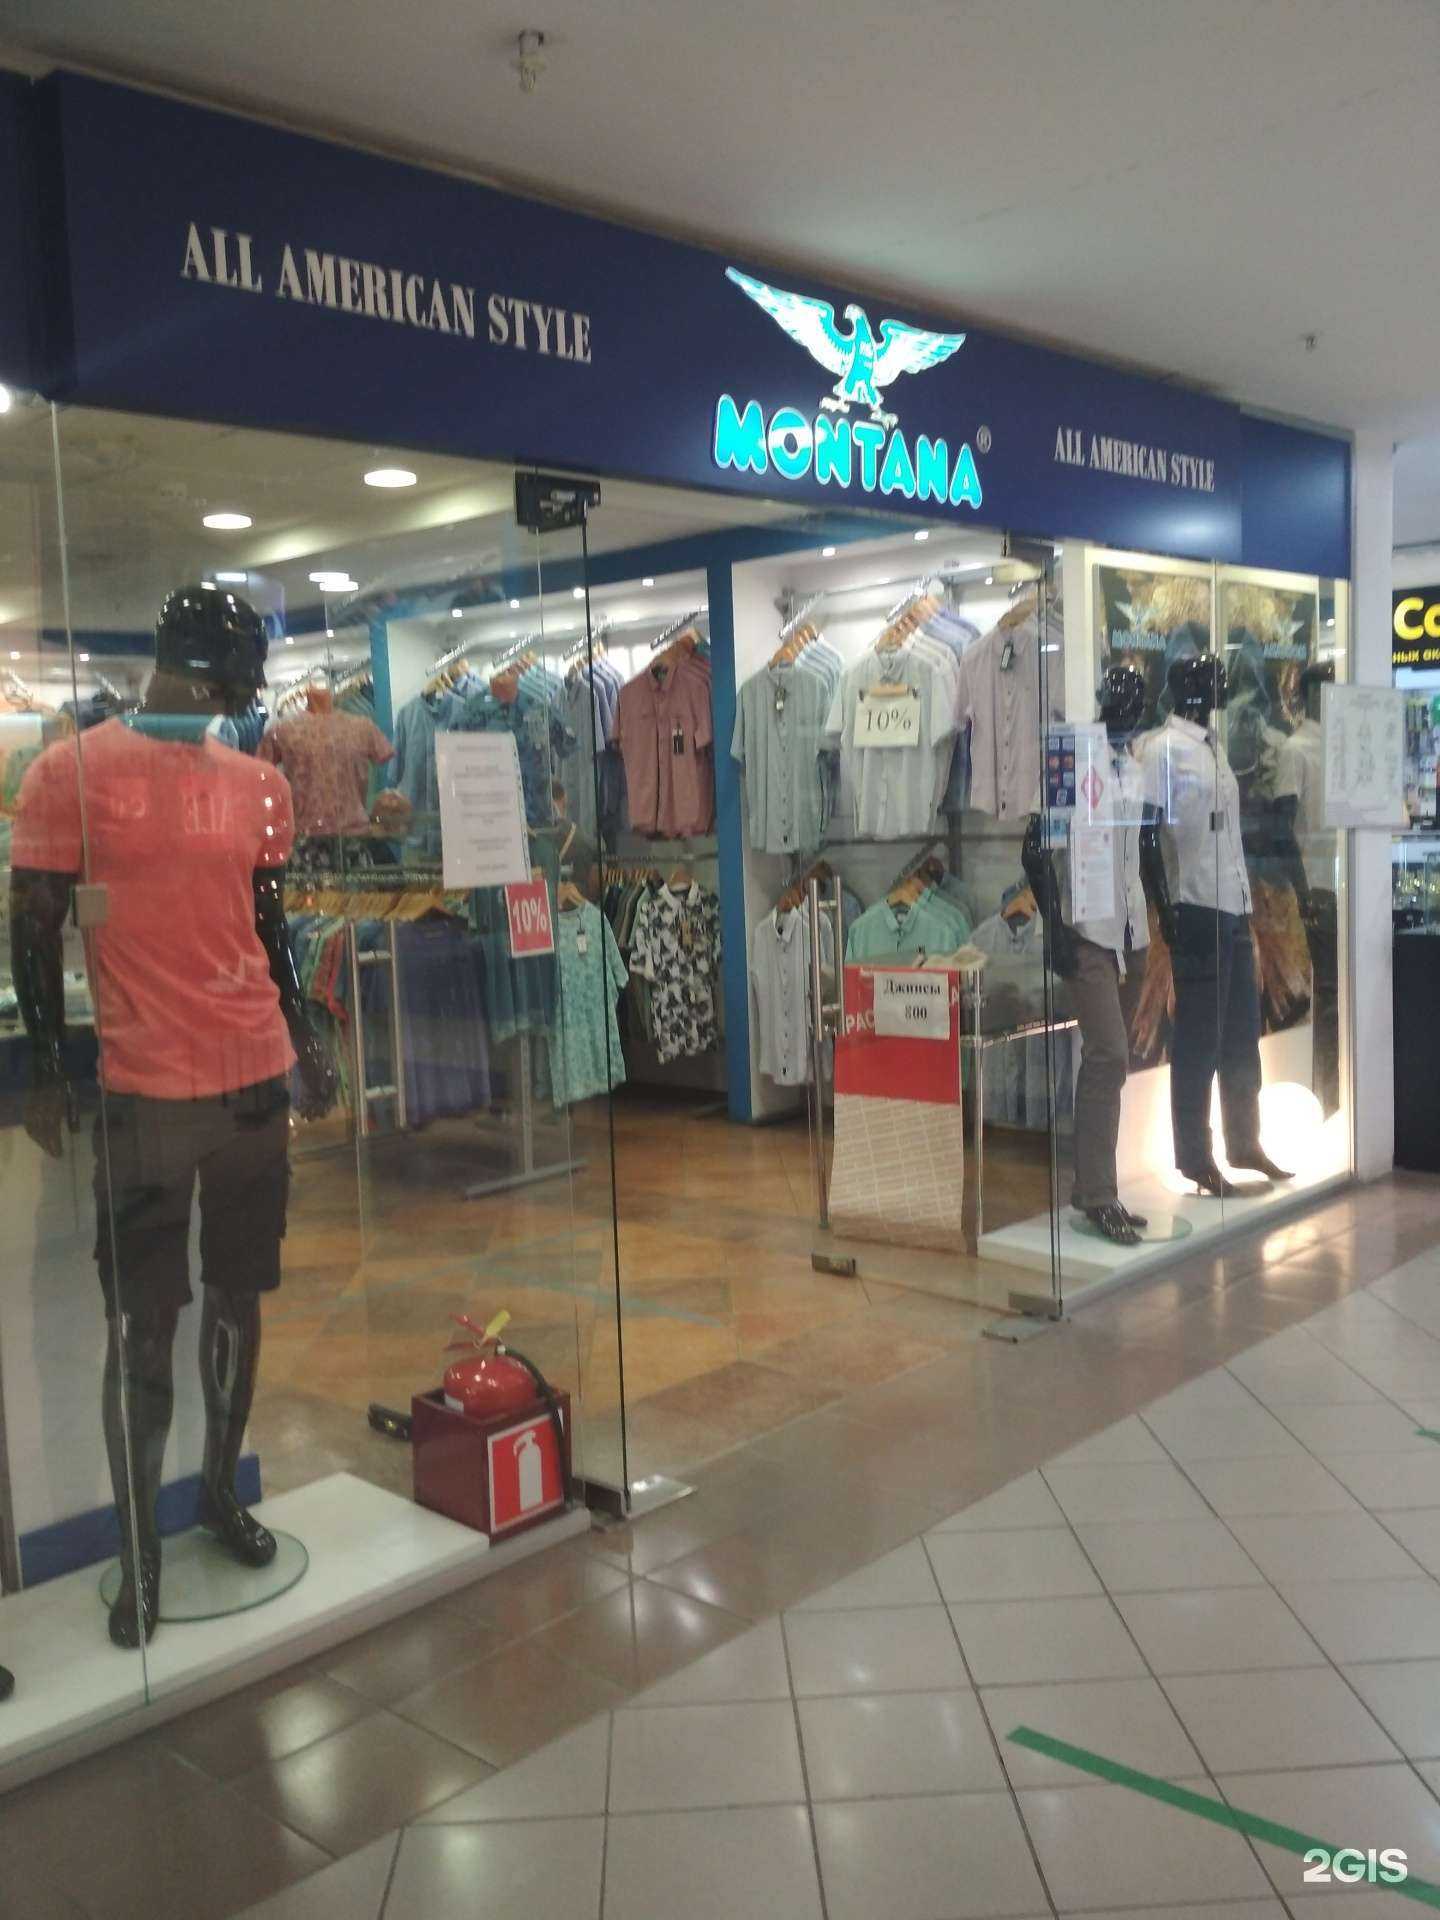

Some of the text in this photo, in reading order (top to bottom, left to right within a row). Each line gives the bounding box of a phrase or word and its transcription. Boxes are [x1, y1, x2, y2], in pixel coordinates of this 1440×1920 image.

[181, 221, 593, 365] ALL AMERICAN STYLE
[714, 393, 983, 510] MONTANA
[1054, 425, 1216, 493] ALL AMERICAN STYLE
[865, 706, 912, 732] 10%
[512, 896, 548, 935] 10%
